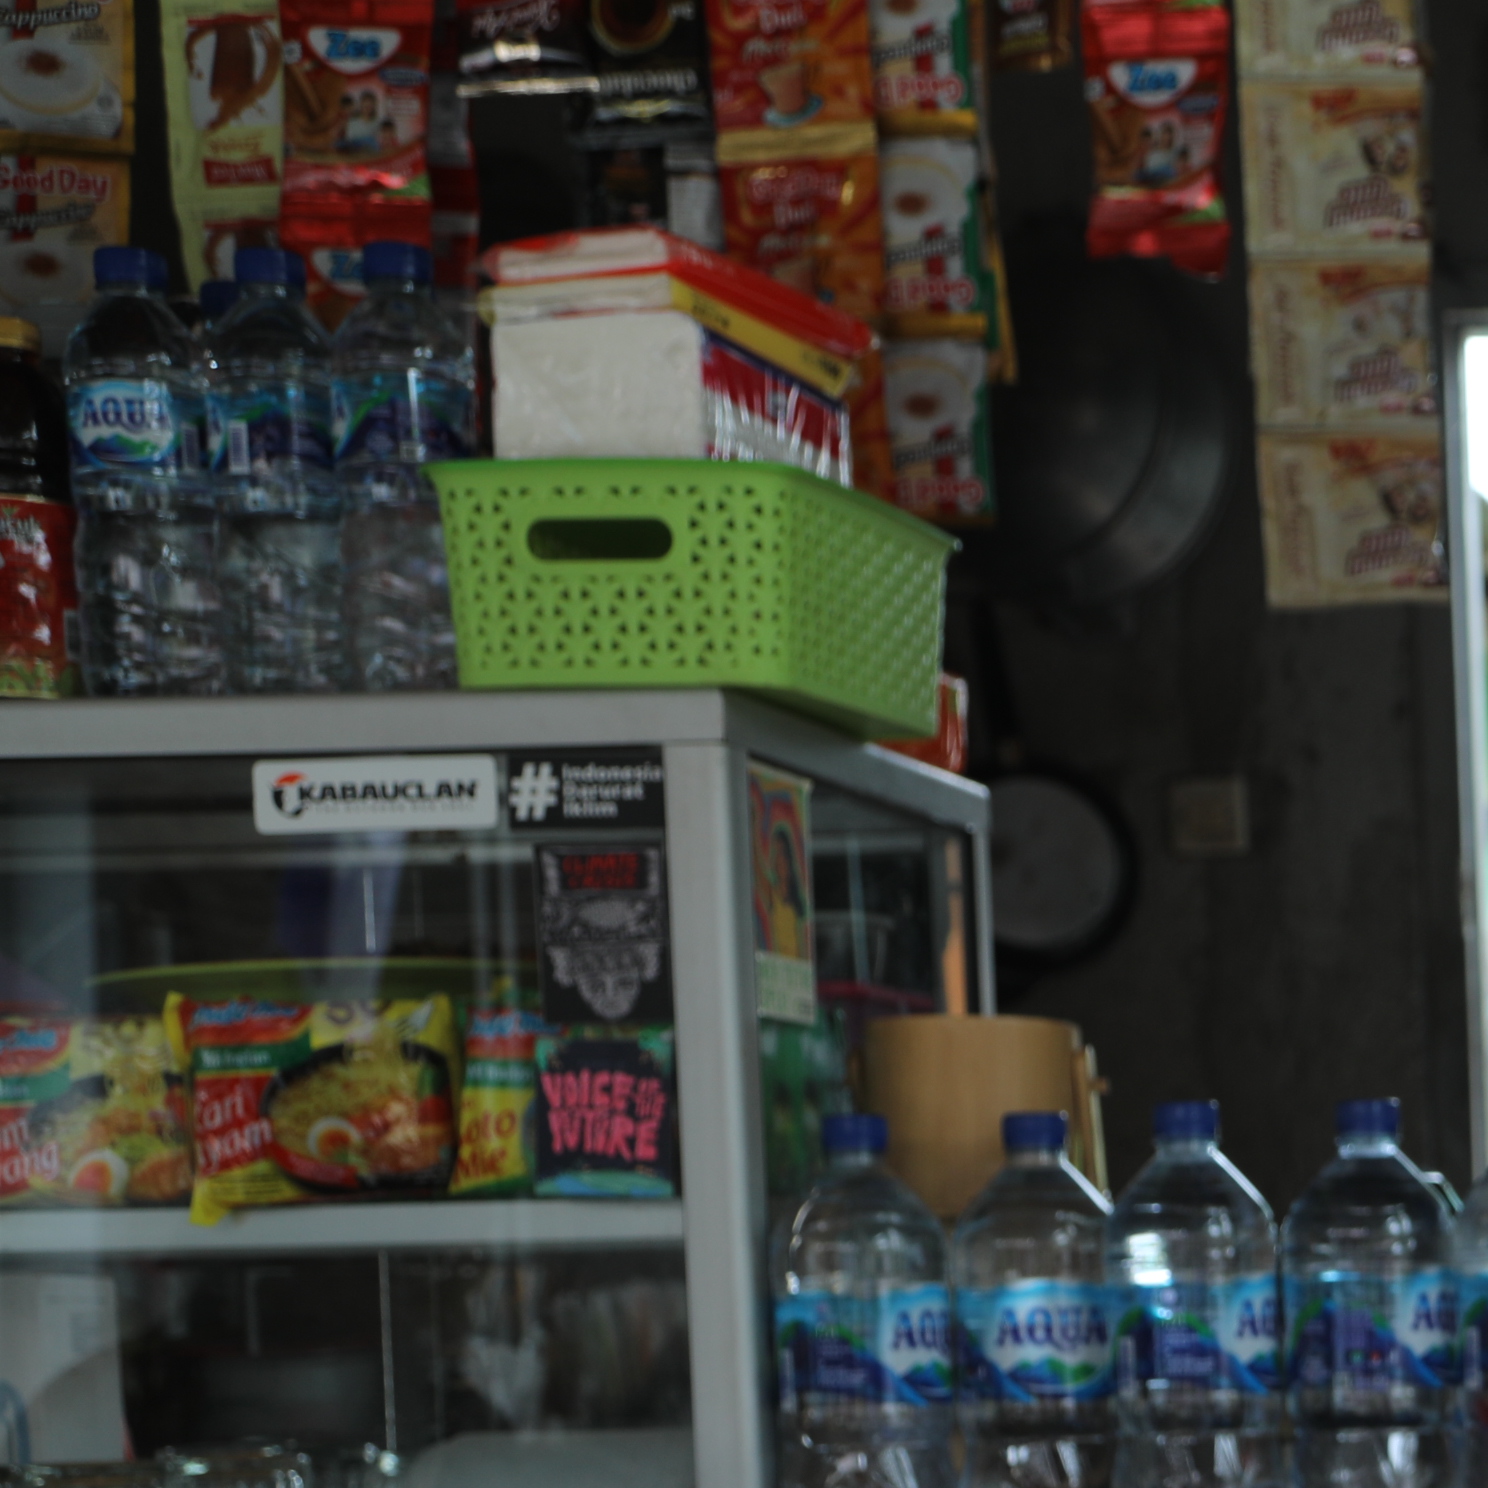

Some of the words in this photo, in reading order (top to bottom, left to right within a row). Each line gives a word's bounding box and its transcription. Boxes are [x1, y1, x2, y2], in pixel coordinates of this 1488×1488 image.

[326, 30, 380, 58] Zee
[59, 166, 110, 203] Day
[562, 762, 663, 782] Indonesia
[299, 780, 476, 800] KABAUCLAN
[563, 800, 618, 818] Iklim
[200, 1081, 247, 1131] ari
[199, 1117, 273, 1173] yam
[997, 1307, 1107, 1352] AQUA
